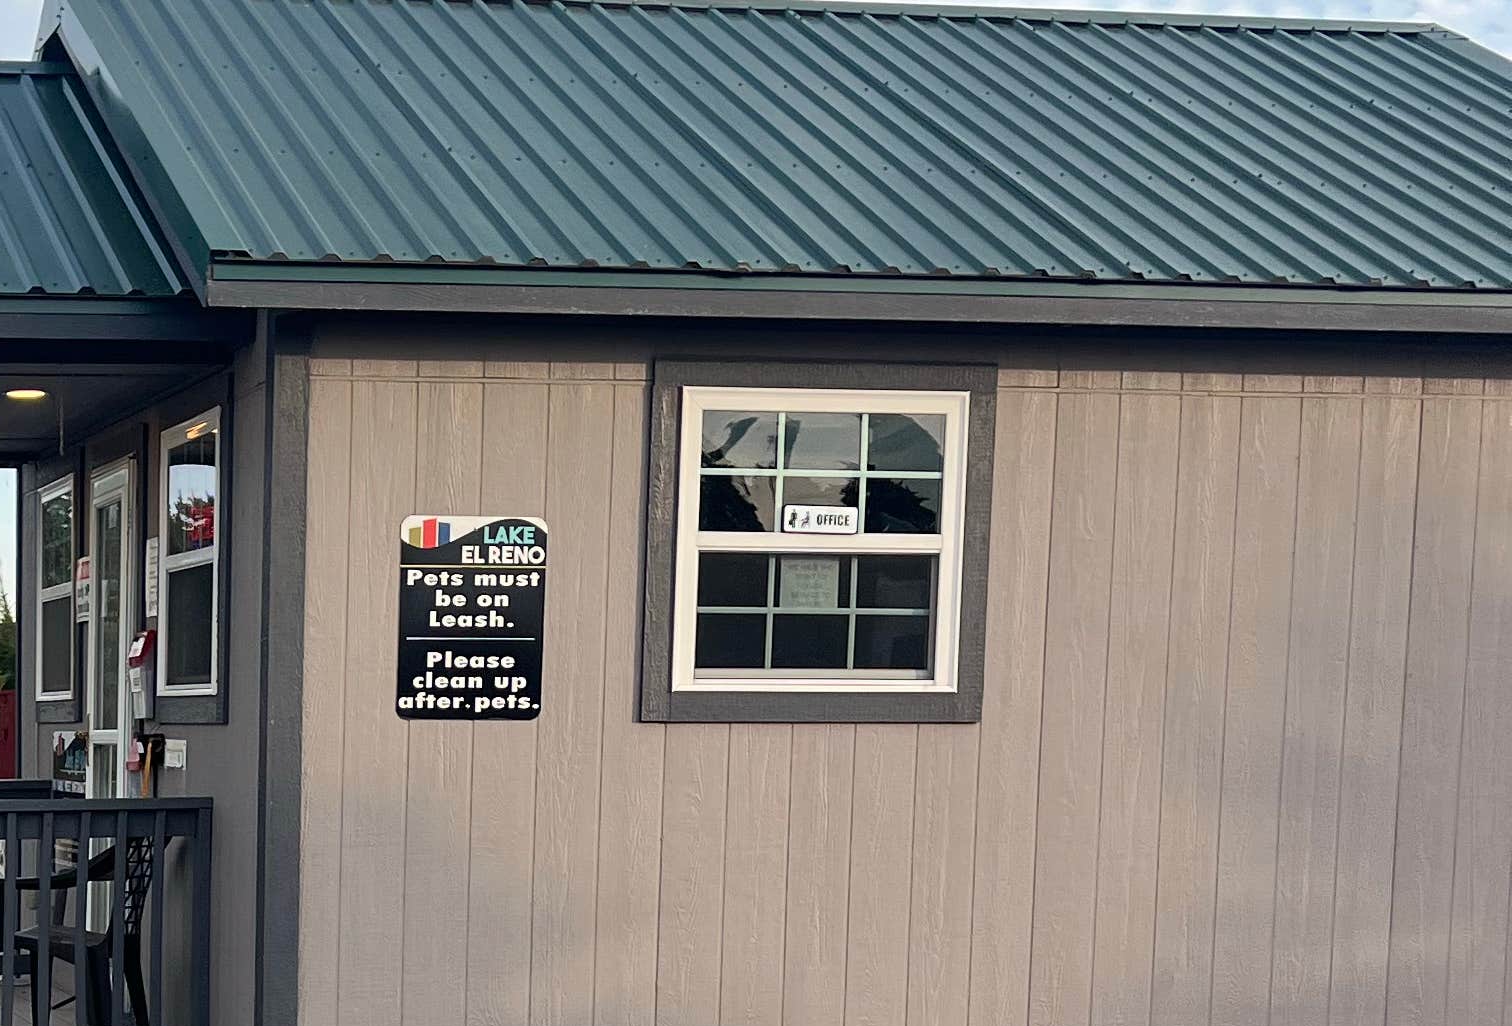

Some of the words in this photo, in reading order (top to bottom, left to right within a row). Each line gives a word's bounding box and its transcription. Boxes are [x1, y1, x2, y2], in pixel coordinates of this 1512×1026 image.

[816, 514, 850, 526] OFFICE
[484, 526, 535, 544] LAKE
[461, 546, 485, 564] EL
[489, 546, 545, 564] RENO
[406, 569, 464, 586] Pets
[474, 571, 540, 587] must
[435, 590, 467, 607] be
[476, 594, 509, 607] on
[429, 611, 514, 628] Leash.
[426, 651, 515, 668] Please
[412, 671, 483, 688] clean
[494, 676, 527, 692] up
[475, 694, 540, 713] pets.
